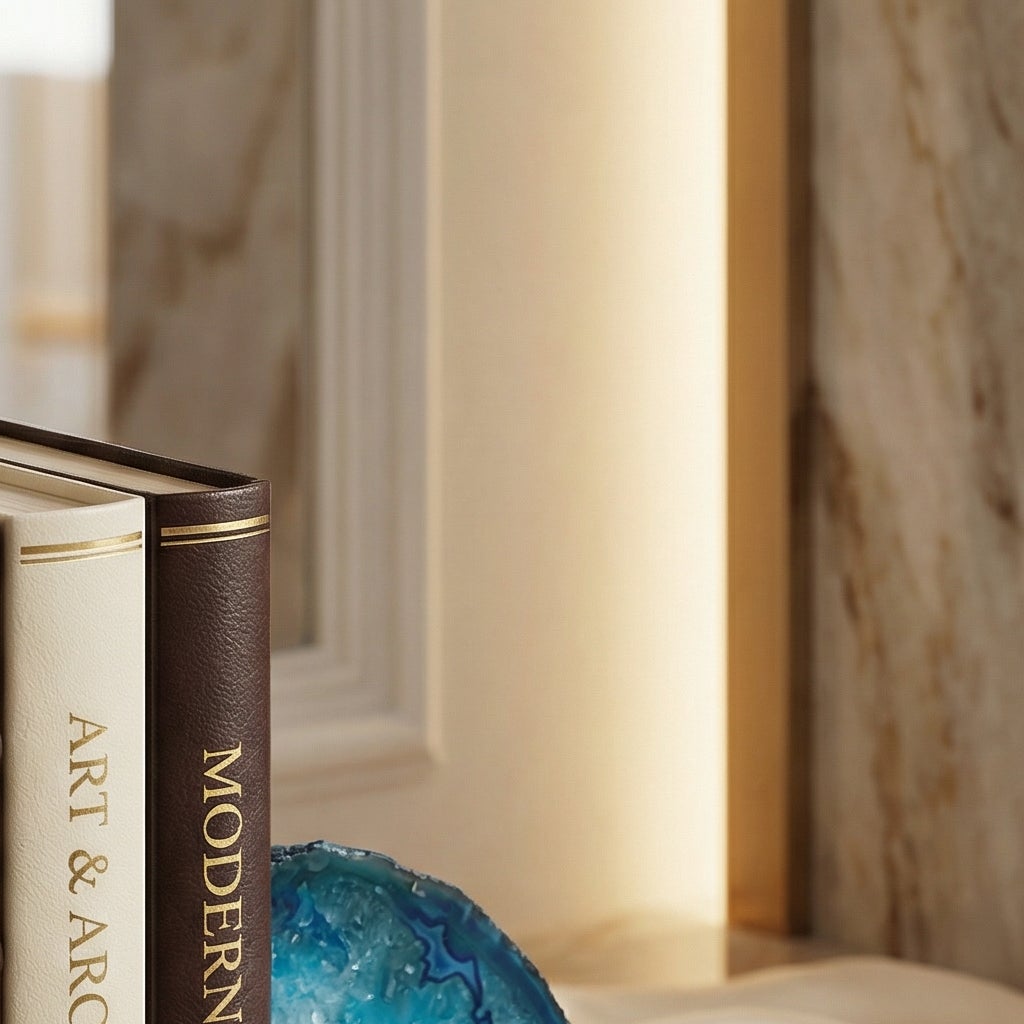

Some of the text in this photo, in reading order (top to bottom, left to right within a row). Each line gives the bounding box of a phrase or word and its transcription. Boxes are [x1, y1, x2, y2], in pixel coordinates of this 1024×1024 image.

[68, 711, 109, 827] ART
[67, 849, 109, 895] &
[202, 741, 243, 1024] MODERN
